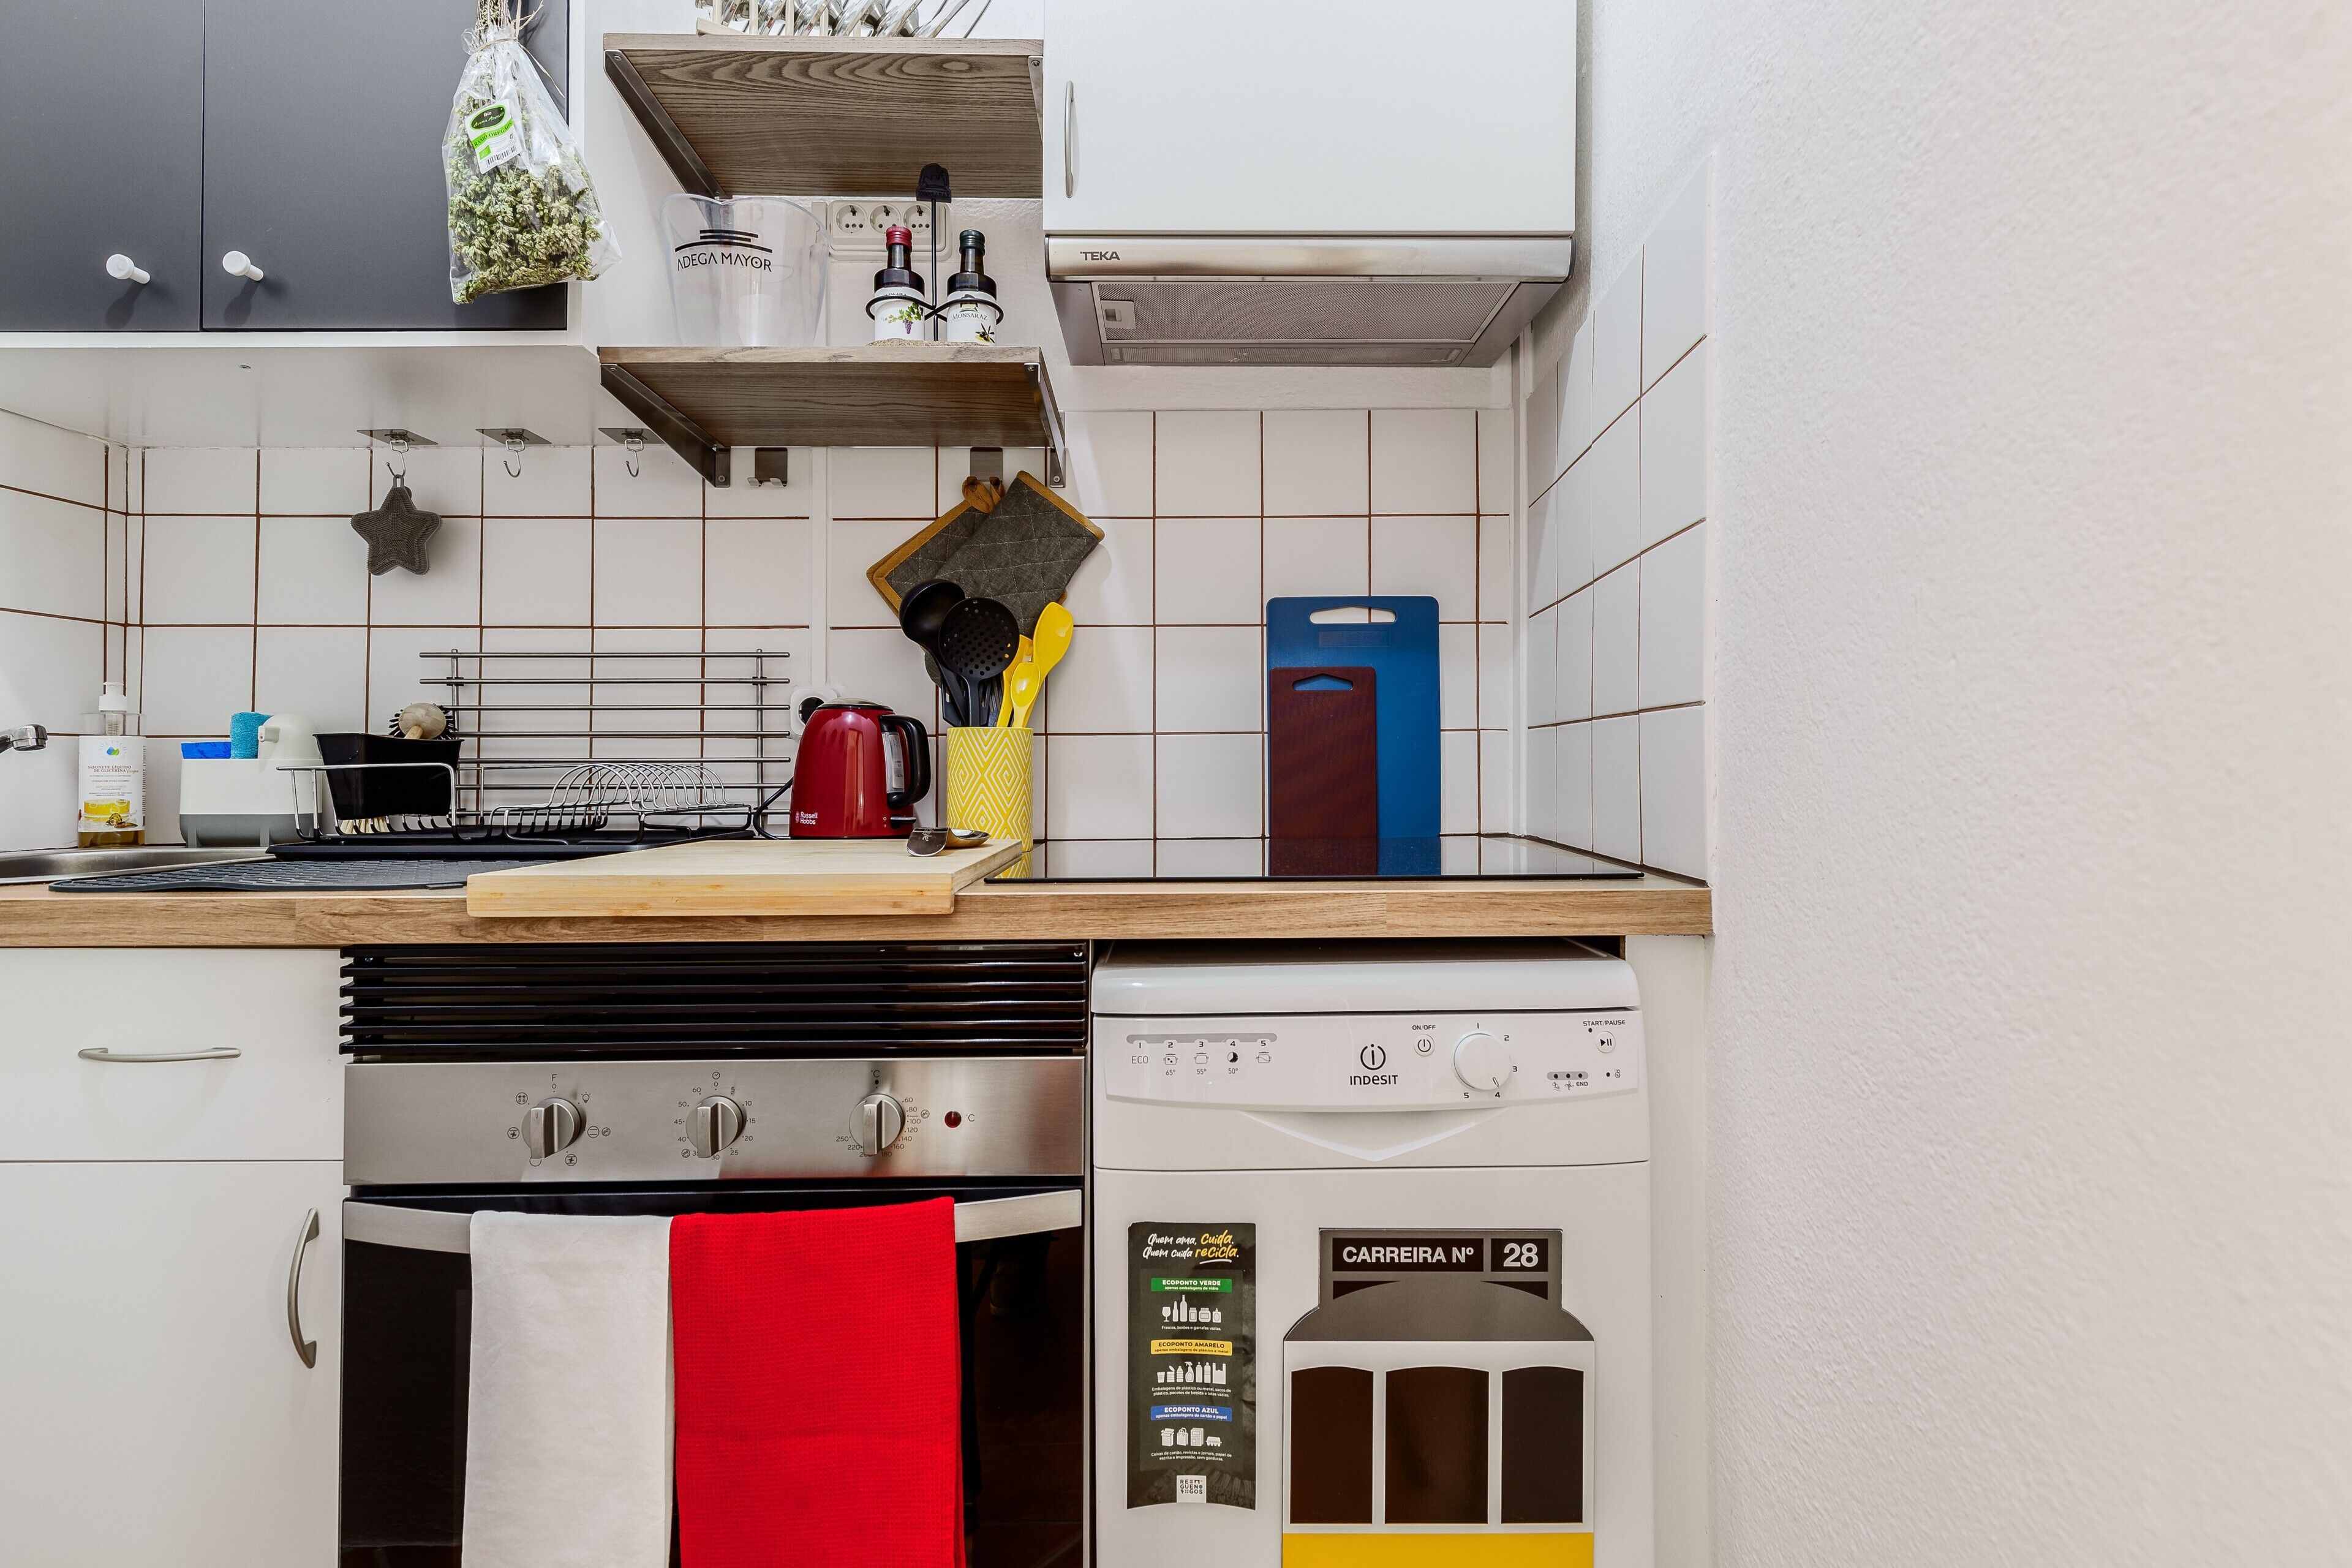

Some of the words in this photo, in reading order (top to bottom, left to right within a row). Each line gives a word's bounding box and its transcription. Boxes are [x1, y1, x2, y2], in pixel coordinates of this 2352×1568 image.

[474, 135, 488, 147] RAMO
[677, 252, 717, 271] ADEGA
[721, 252, 772, 272] MAYOR
[1081, 251, 1120, 261] TEKA
[1148, 1233, 1174, 1246] Quem
[1176, 1236, 1197, 1245] ama,
[1143, 1246, 1169, 1259] Quem
[1342, 1246, 1446, 1263] CARREIRA
[1503, 1243, 1539, 1267] 28
